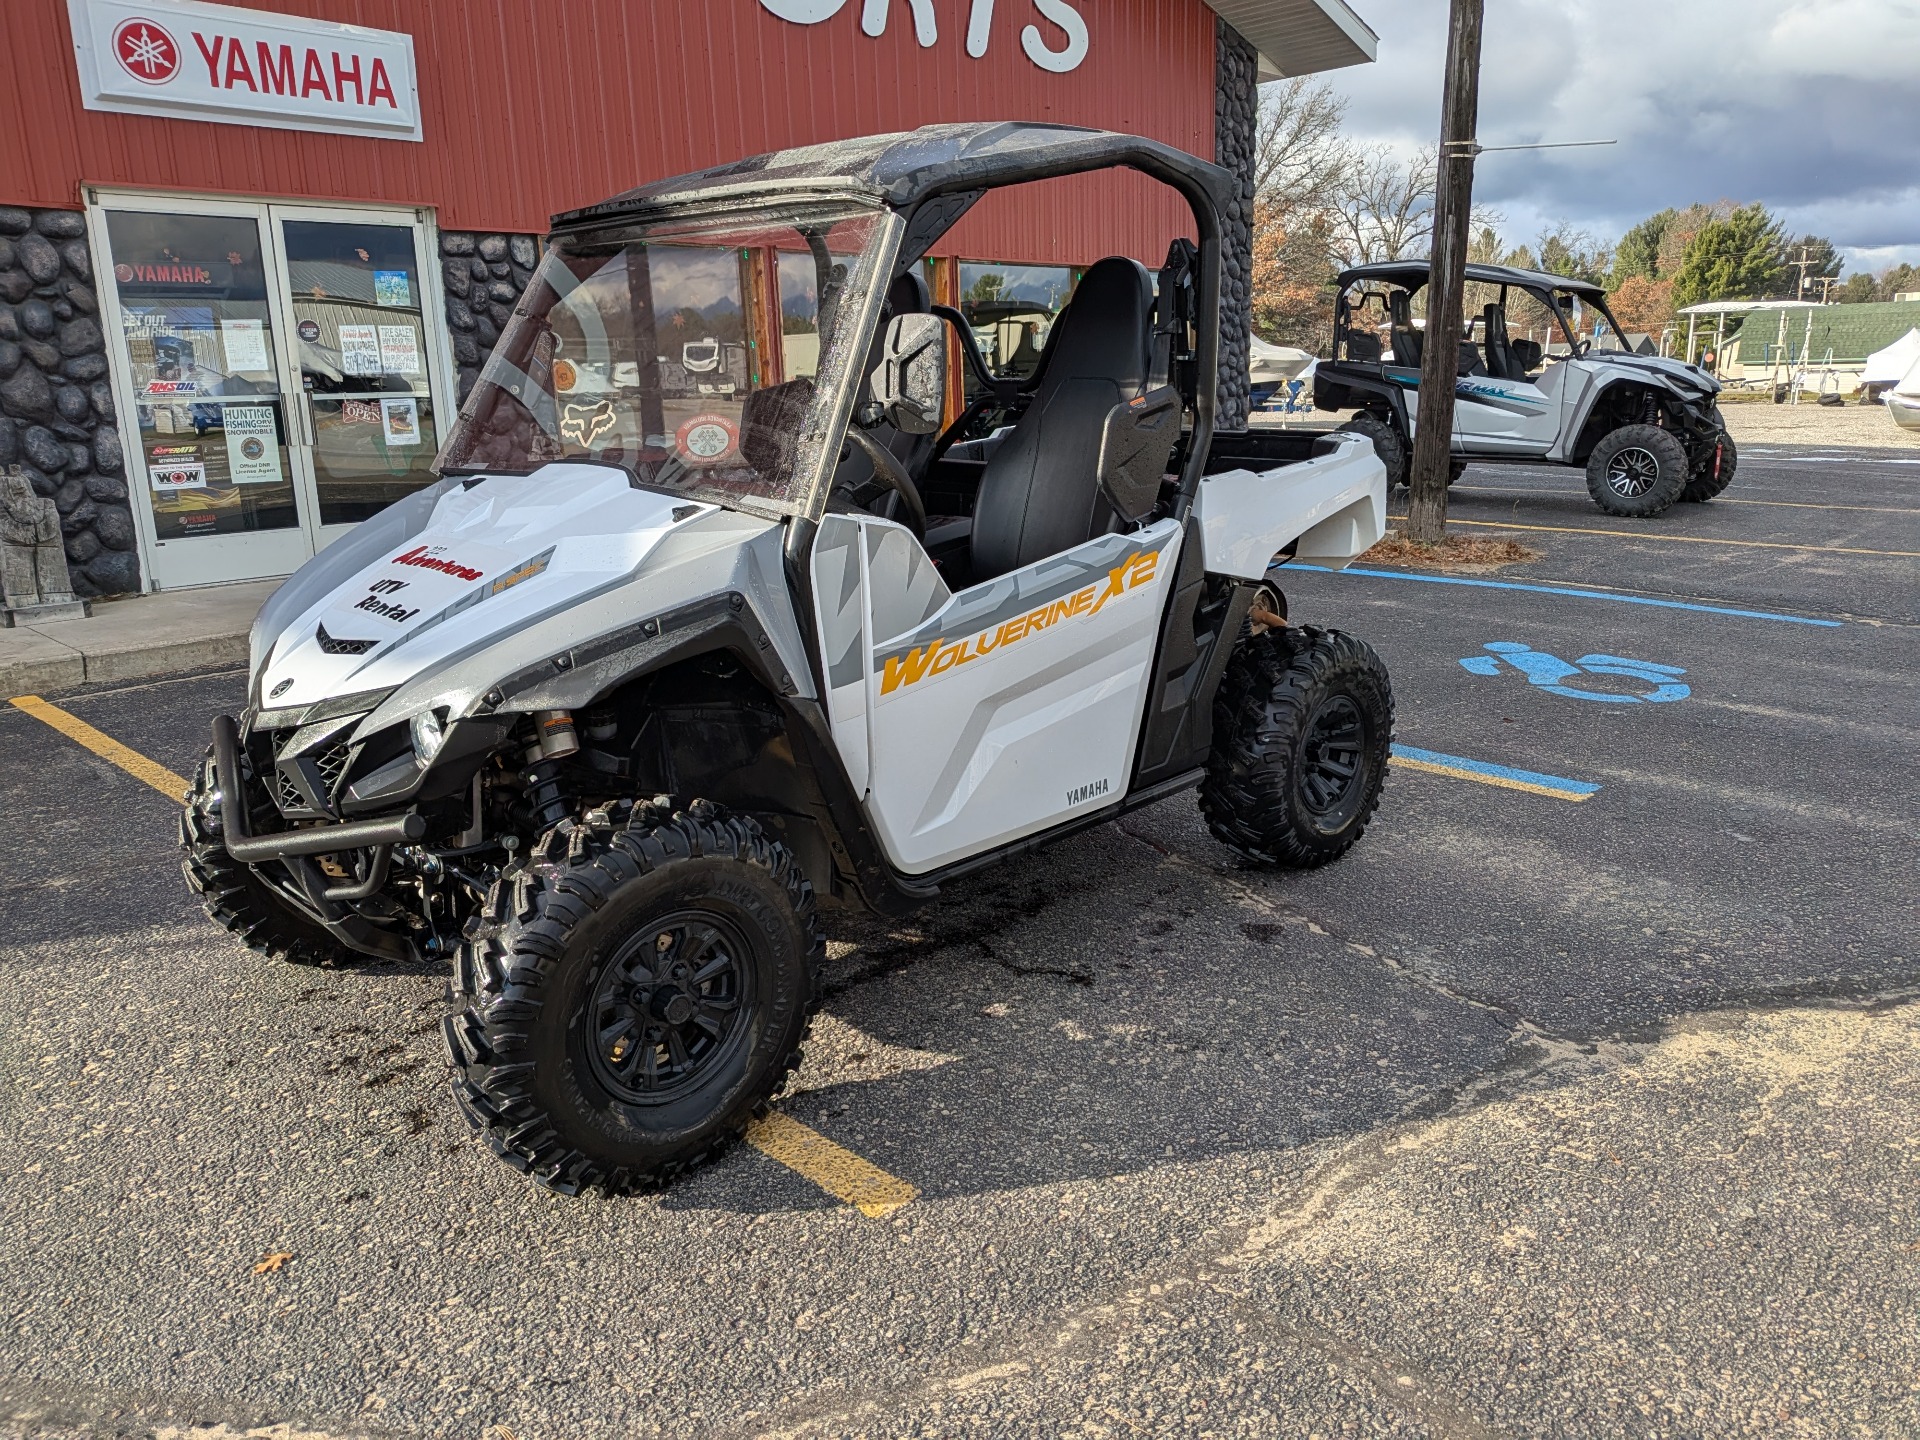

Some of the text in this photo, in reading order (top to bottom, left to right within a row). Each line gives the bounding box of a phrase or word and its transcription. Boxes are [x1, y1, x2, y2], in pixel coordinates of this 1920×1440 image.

[191, 32, 398, 109] YAMAHA
[134, 266, 205, 283] YAMAHA
[122, 314, 167, 327] GET OUT
[126, 325, 175, 338] AND RIDE
[381, 327, 394, 338] TIRE
[362, 354, 378, 371] OFF
[391, 354, 416, 363] PURCHASE
[146, 381, 196, 393] AMSOIL
[224, 408, 272, 420] HUNTING
[347, 406, 381, 421] OPEN
[225, 419, 257, 429] FISHING
[226, 428, 274, 436] SNOWMOBILE
[154, 470, 201, 485] WOW
[187, 514, 217, 523] YAMAHA
[391, 545, 484, 582] Adventures
[368, 578, 410, 595] UTV
[353, 595, 421, 623] Rental
[1066, 778, 1109, 806] YAMAHA
